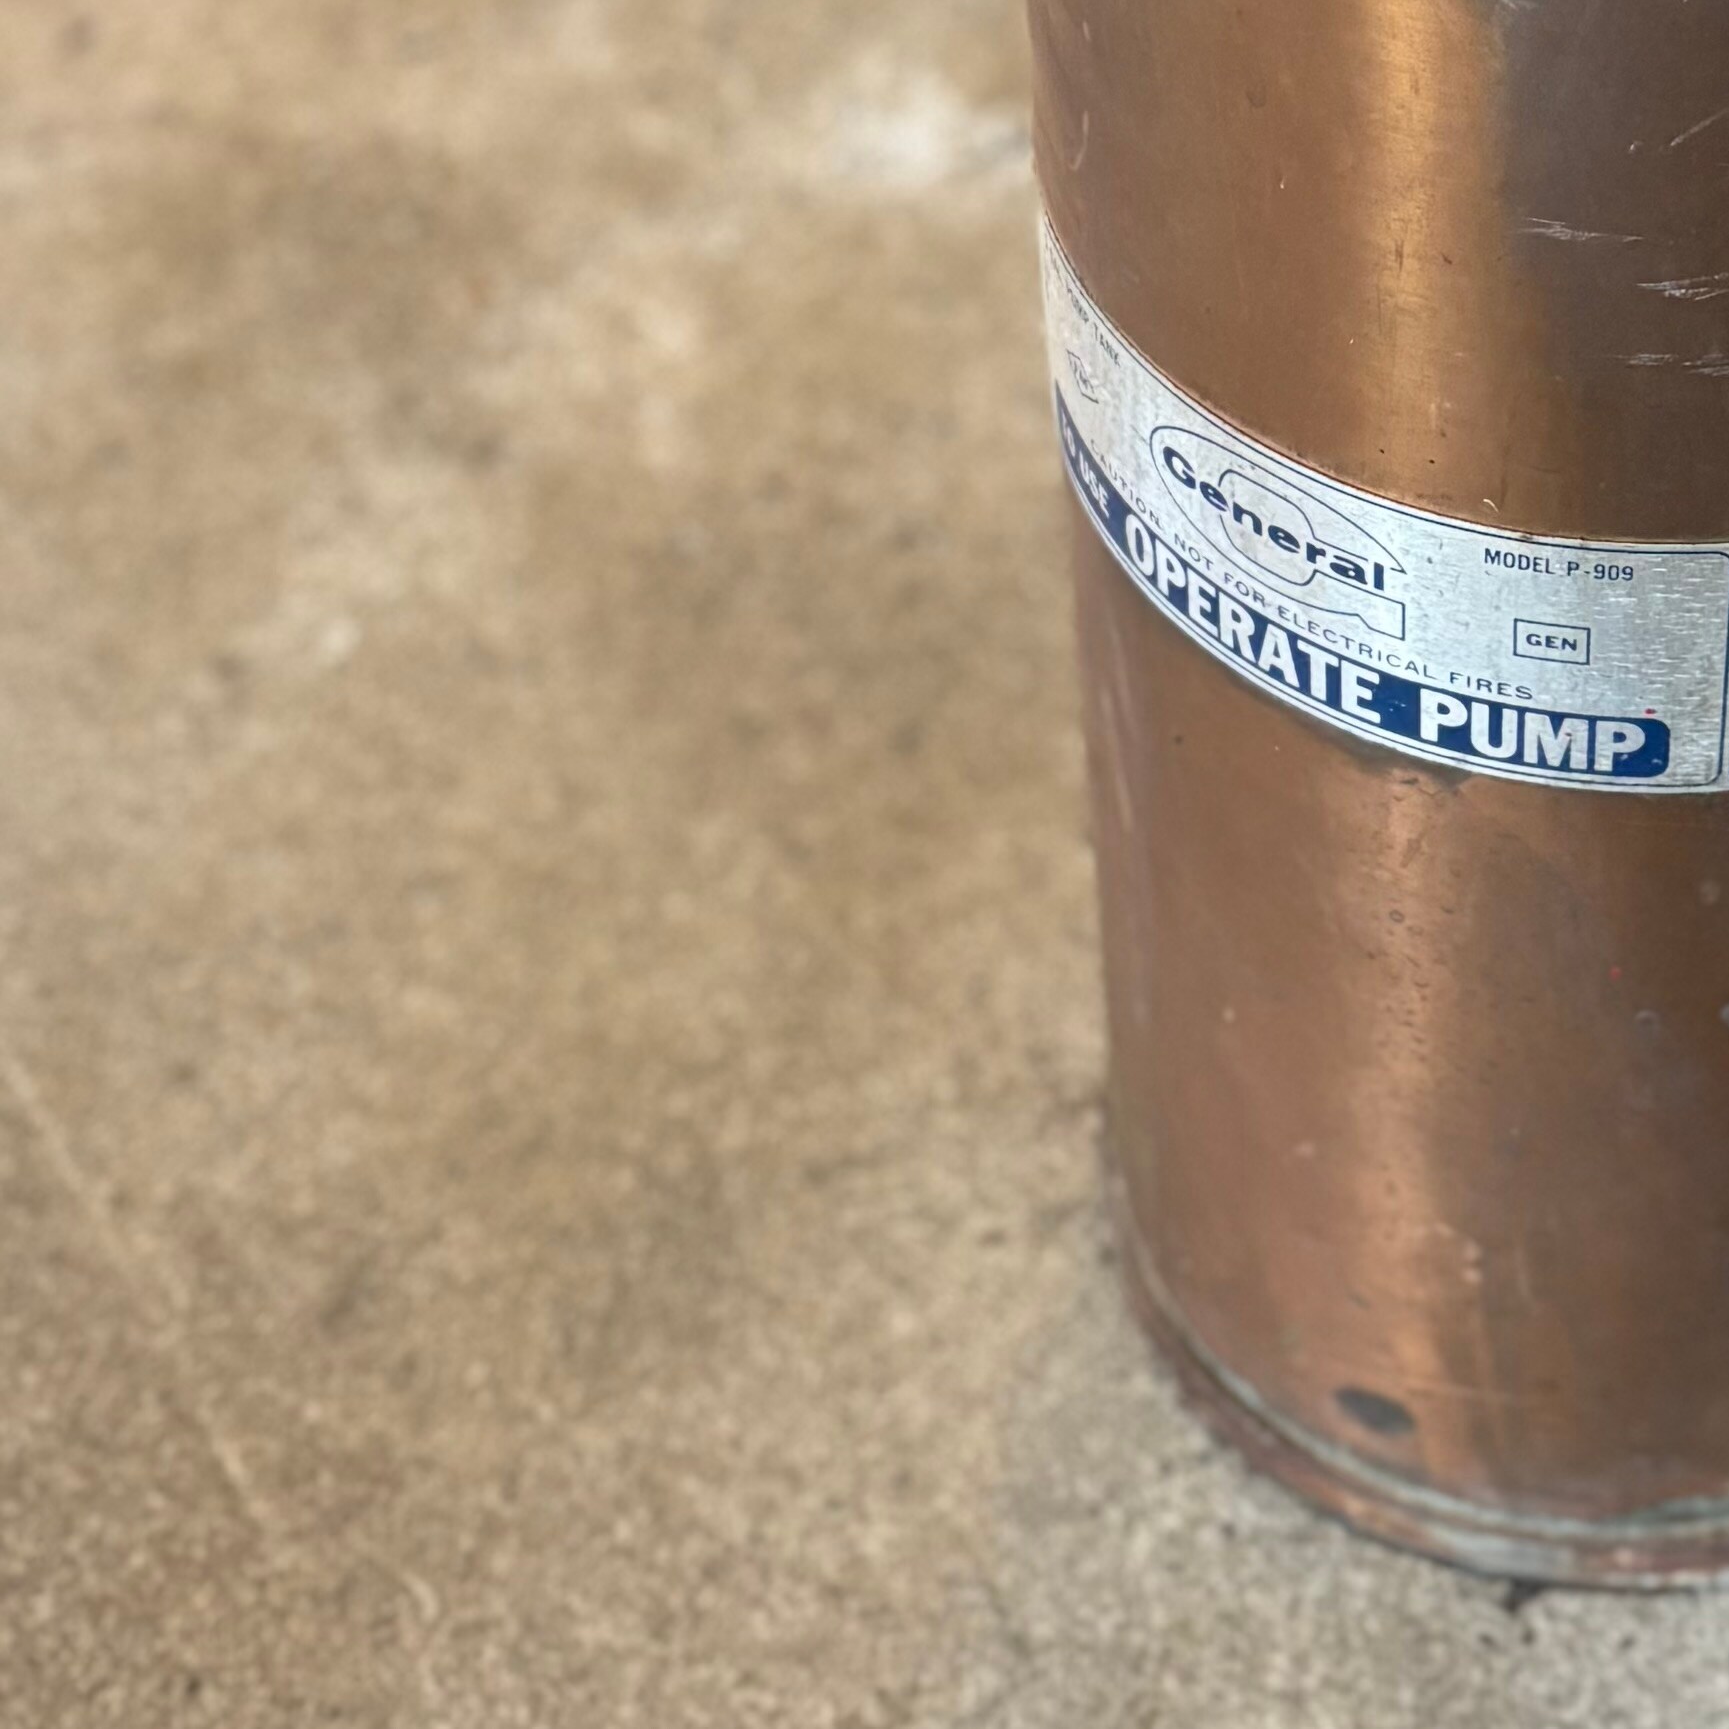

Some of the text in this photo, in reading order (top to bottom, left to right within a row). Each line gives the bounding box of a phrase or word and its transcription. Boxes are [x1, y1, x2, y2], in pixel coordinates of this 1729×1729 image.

[1163, 446, 1384, 591] General
[1484, 547, 1635, 582] MODEL P-909
[1080, 449, 1110, 519] USE
[1125, 514, 1381, 723] OPERATE
[1419, 687, 1646, 772] PUMP
[1174, 533, 1214, 569] NOT
[1224, 574, 1266, 609] FOR
[1278, 606, 1437, 680] ELECTRICAL
[1449, 671, 1534, 701] FIRES
[1526, 633, 1578, 652] GEN
